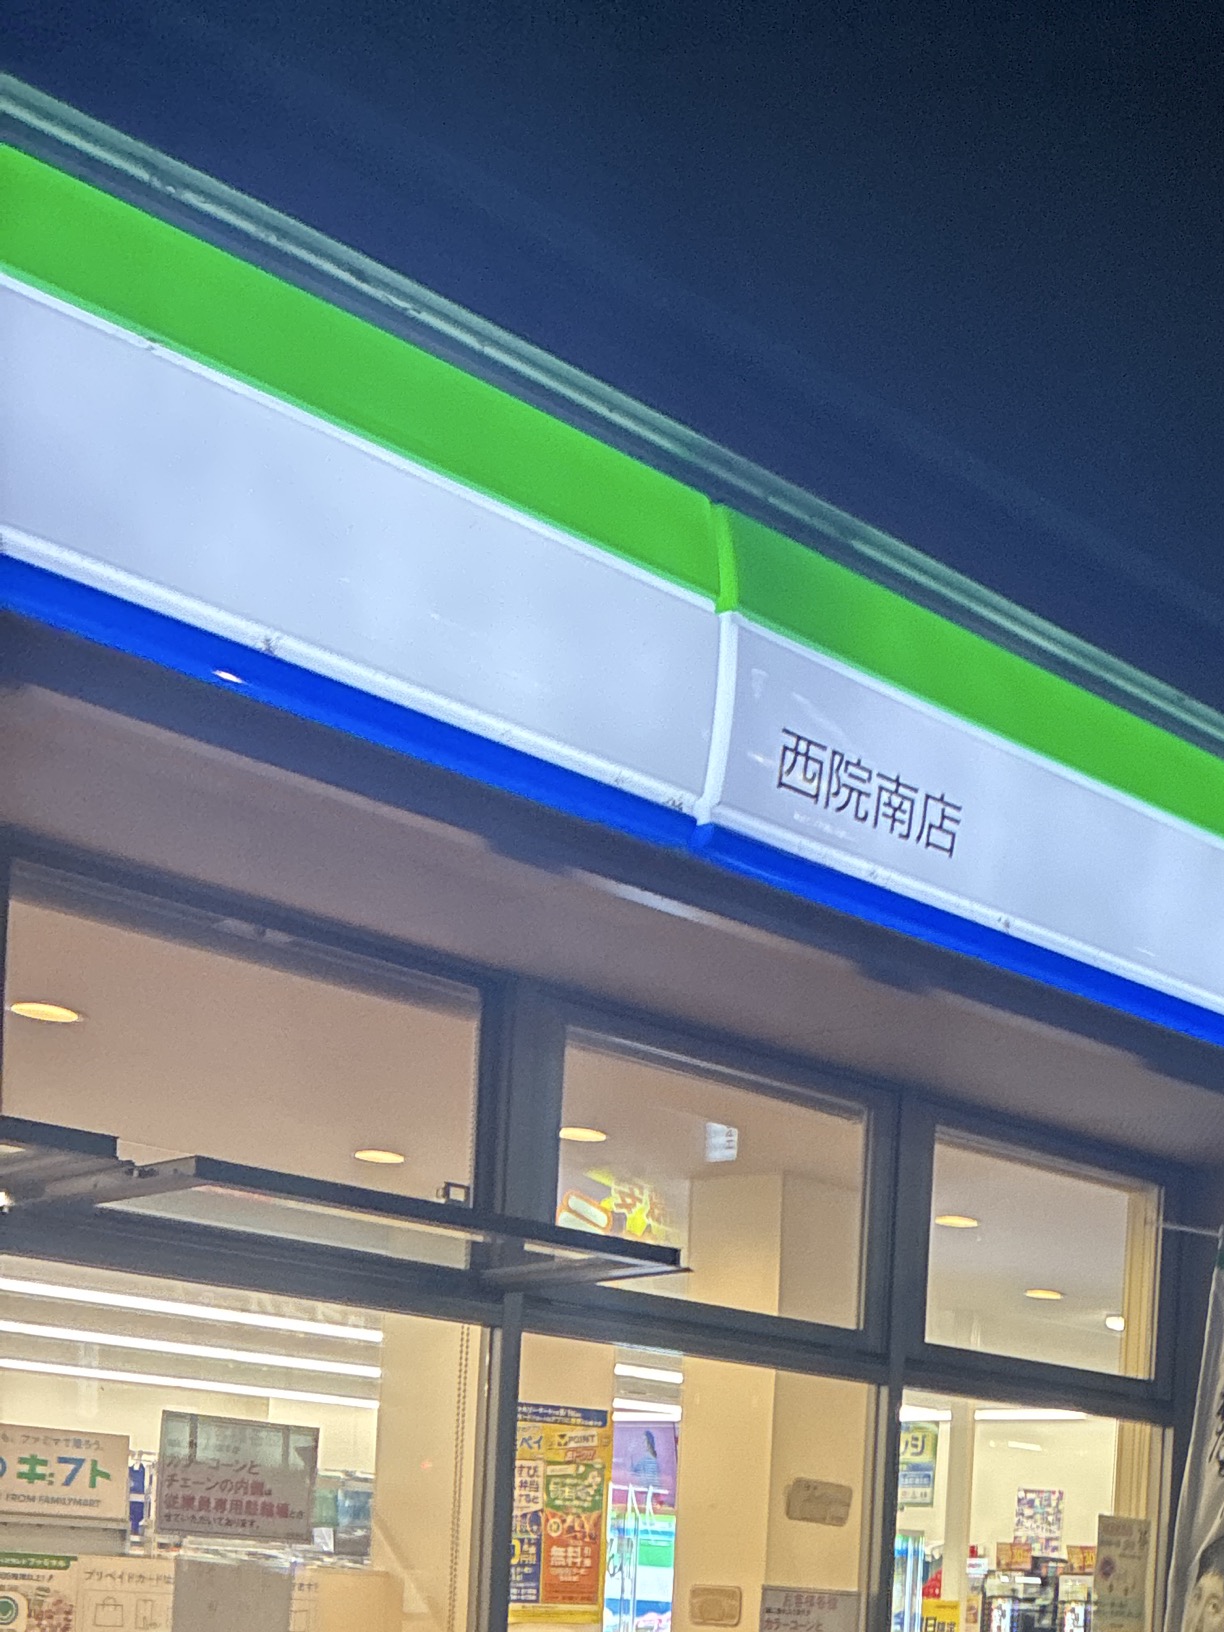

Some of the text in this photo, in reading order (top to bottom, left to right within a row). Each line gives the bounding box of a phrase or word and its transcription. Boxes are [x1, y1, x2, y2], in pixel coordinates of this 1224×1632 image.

[777, 728, 962, 858] 西院南店
[0, 1454, 112, 1489] ギフト
